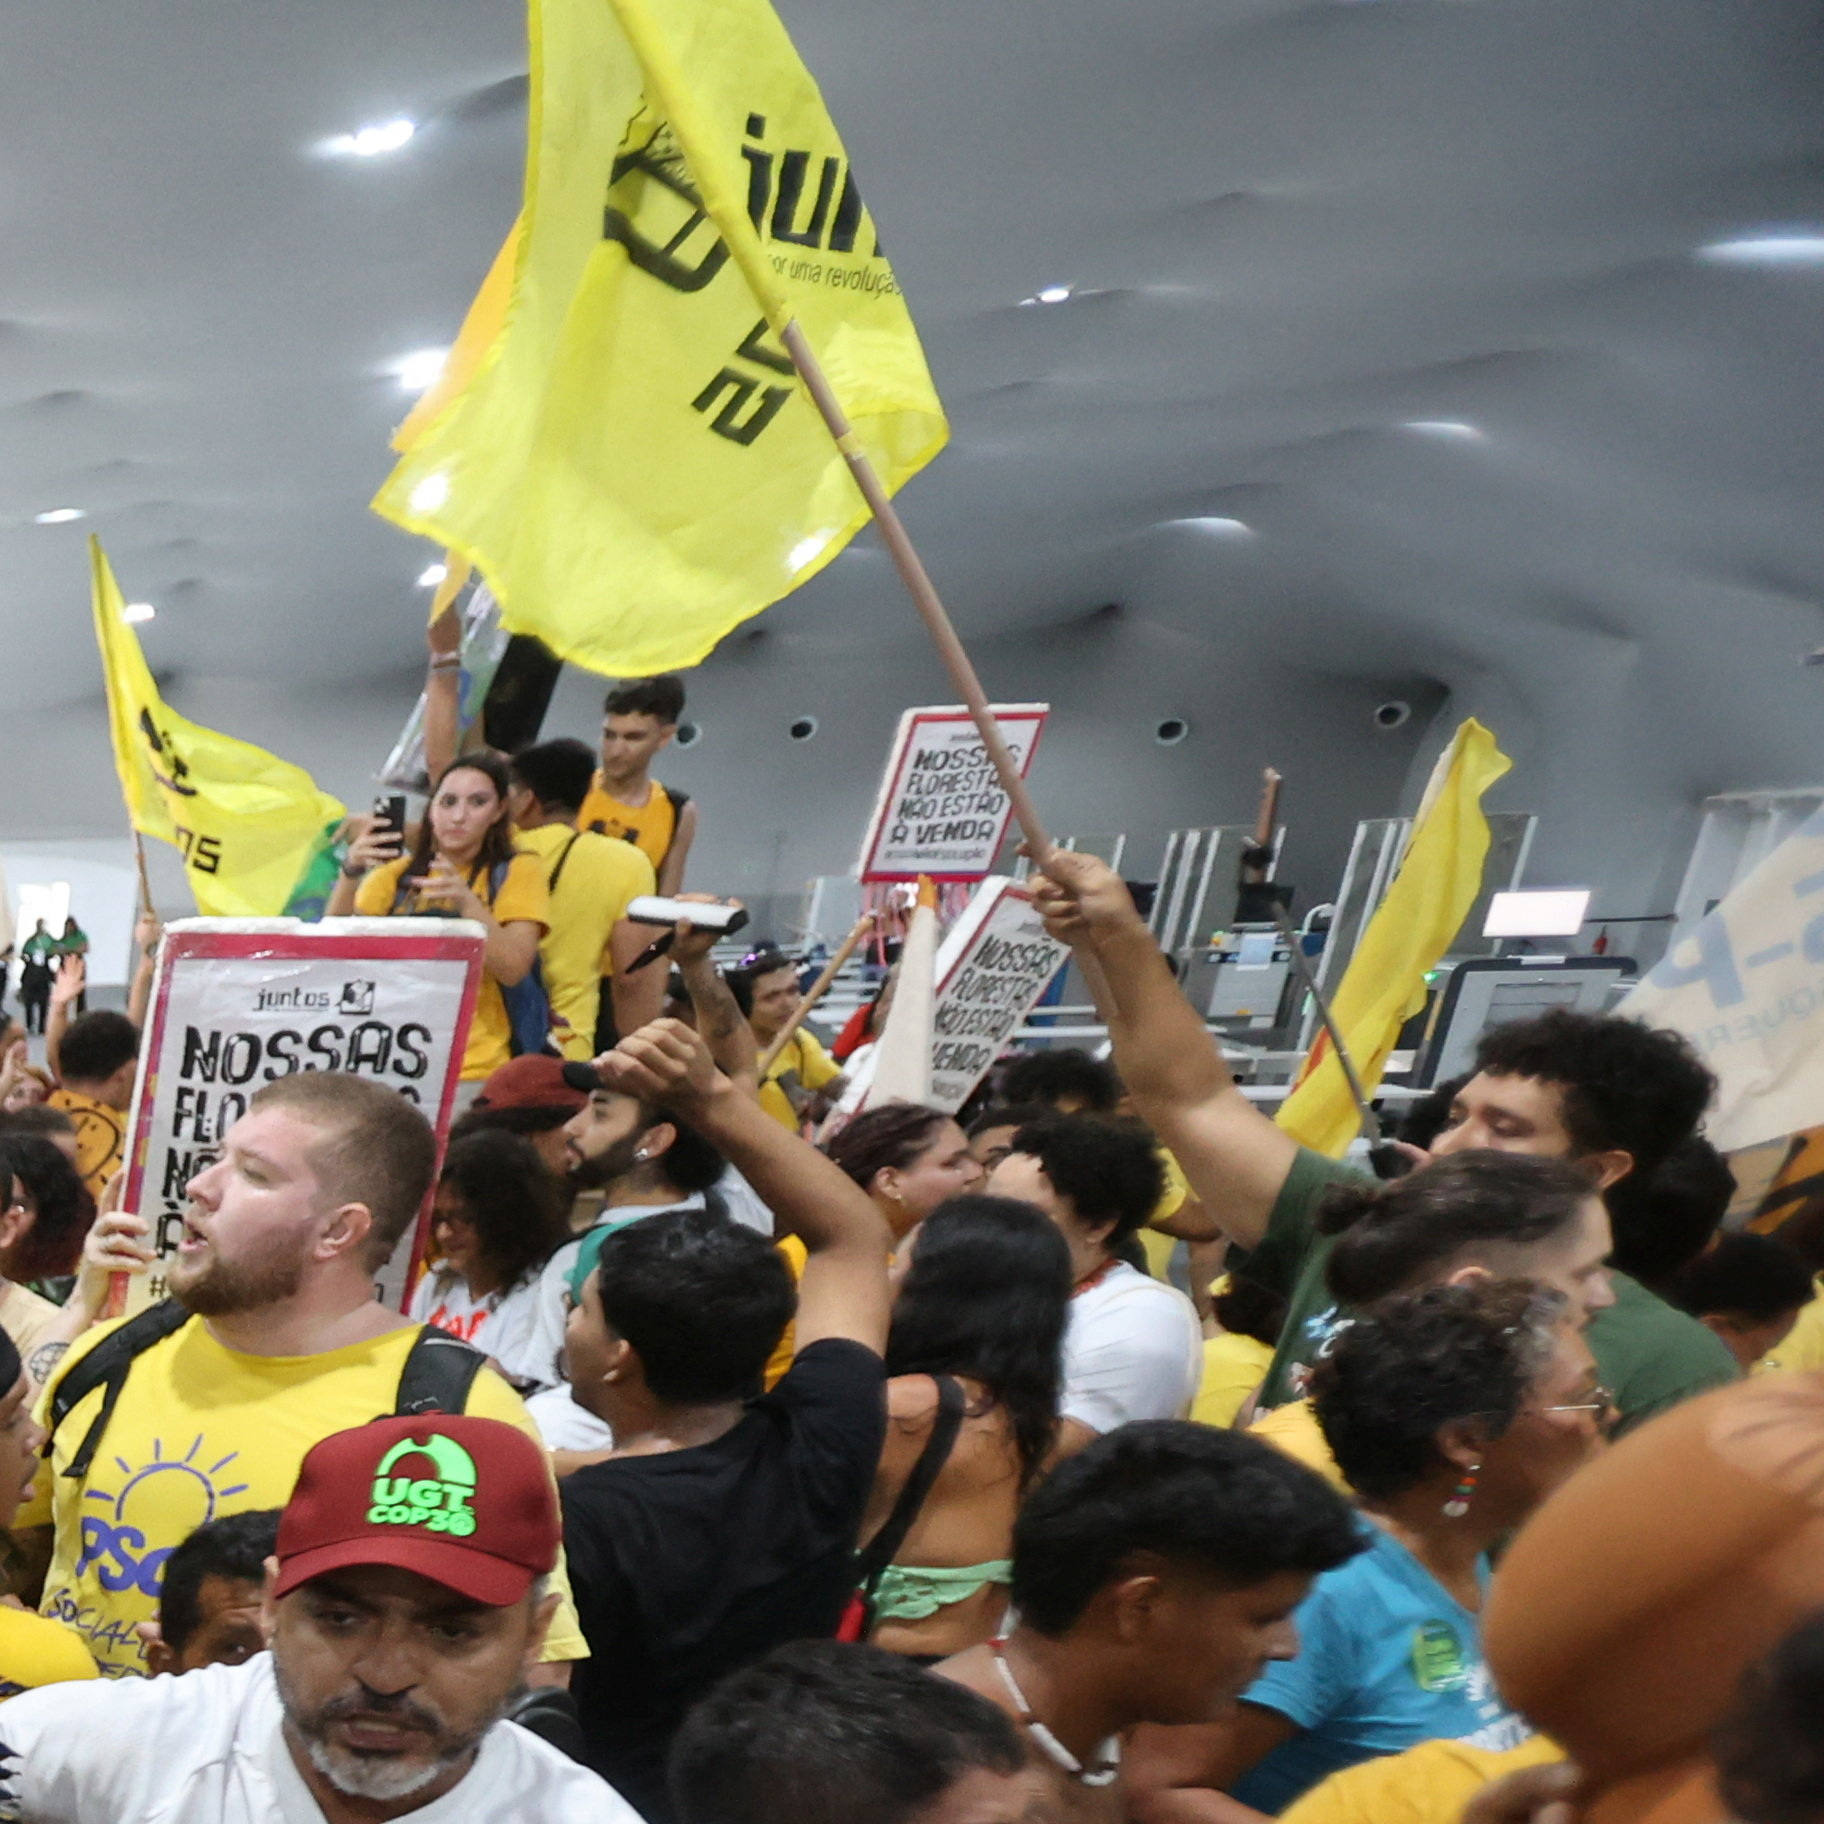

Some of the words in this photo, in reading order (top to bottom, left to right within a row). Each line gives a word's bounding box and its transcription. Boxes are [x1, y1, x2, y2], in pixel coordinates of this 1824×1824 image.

[790, 260, 821, 283] uma
[826, 265, 903, 300] revoluçã
[913, 744, 1021, 770] NOSSS
[905, 768, 1002, 796] FLORESTA
[916, 820, 995, 845] VENDA
[253, 987, 331, 1011] juntos
[180, 1021, 432, 1085] NOSSAS
[372, 1477, 475, 1512] UGT
[367, 1504, 477, 1536] COP30
